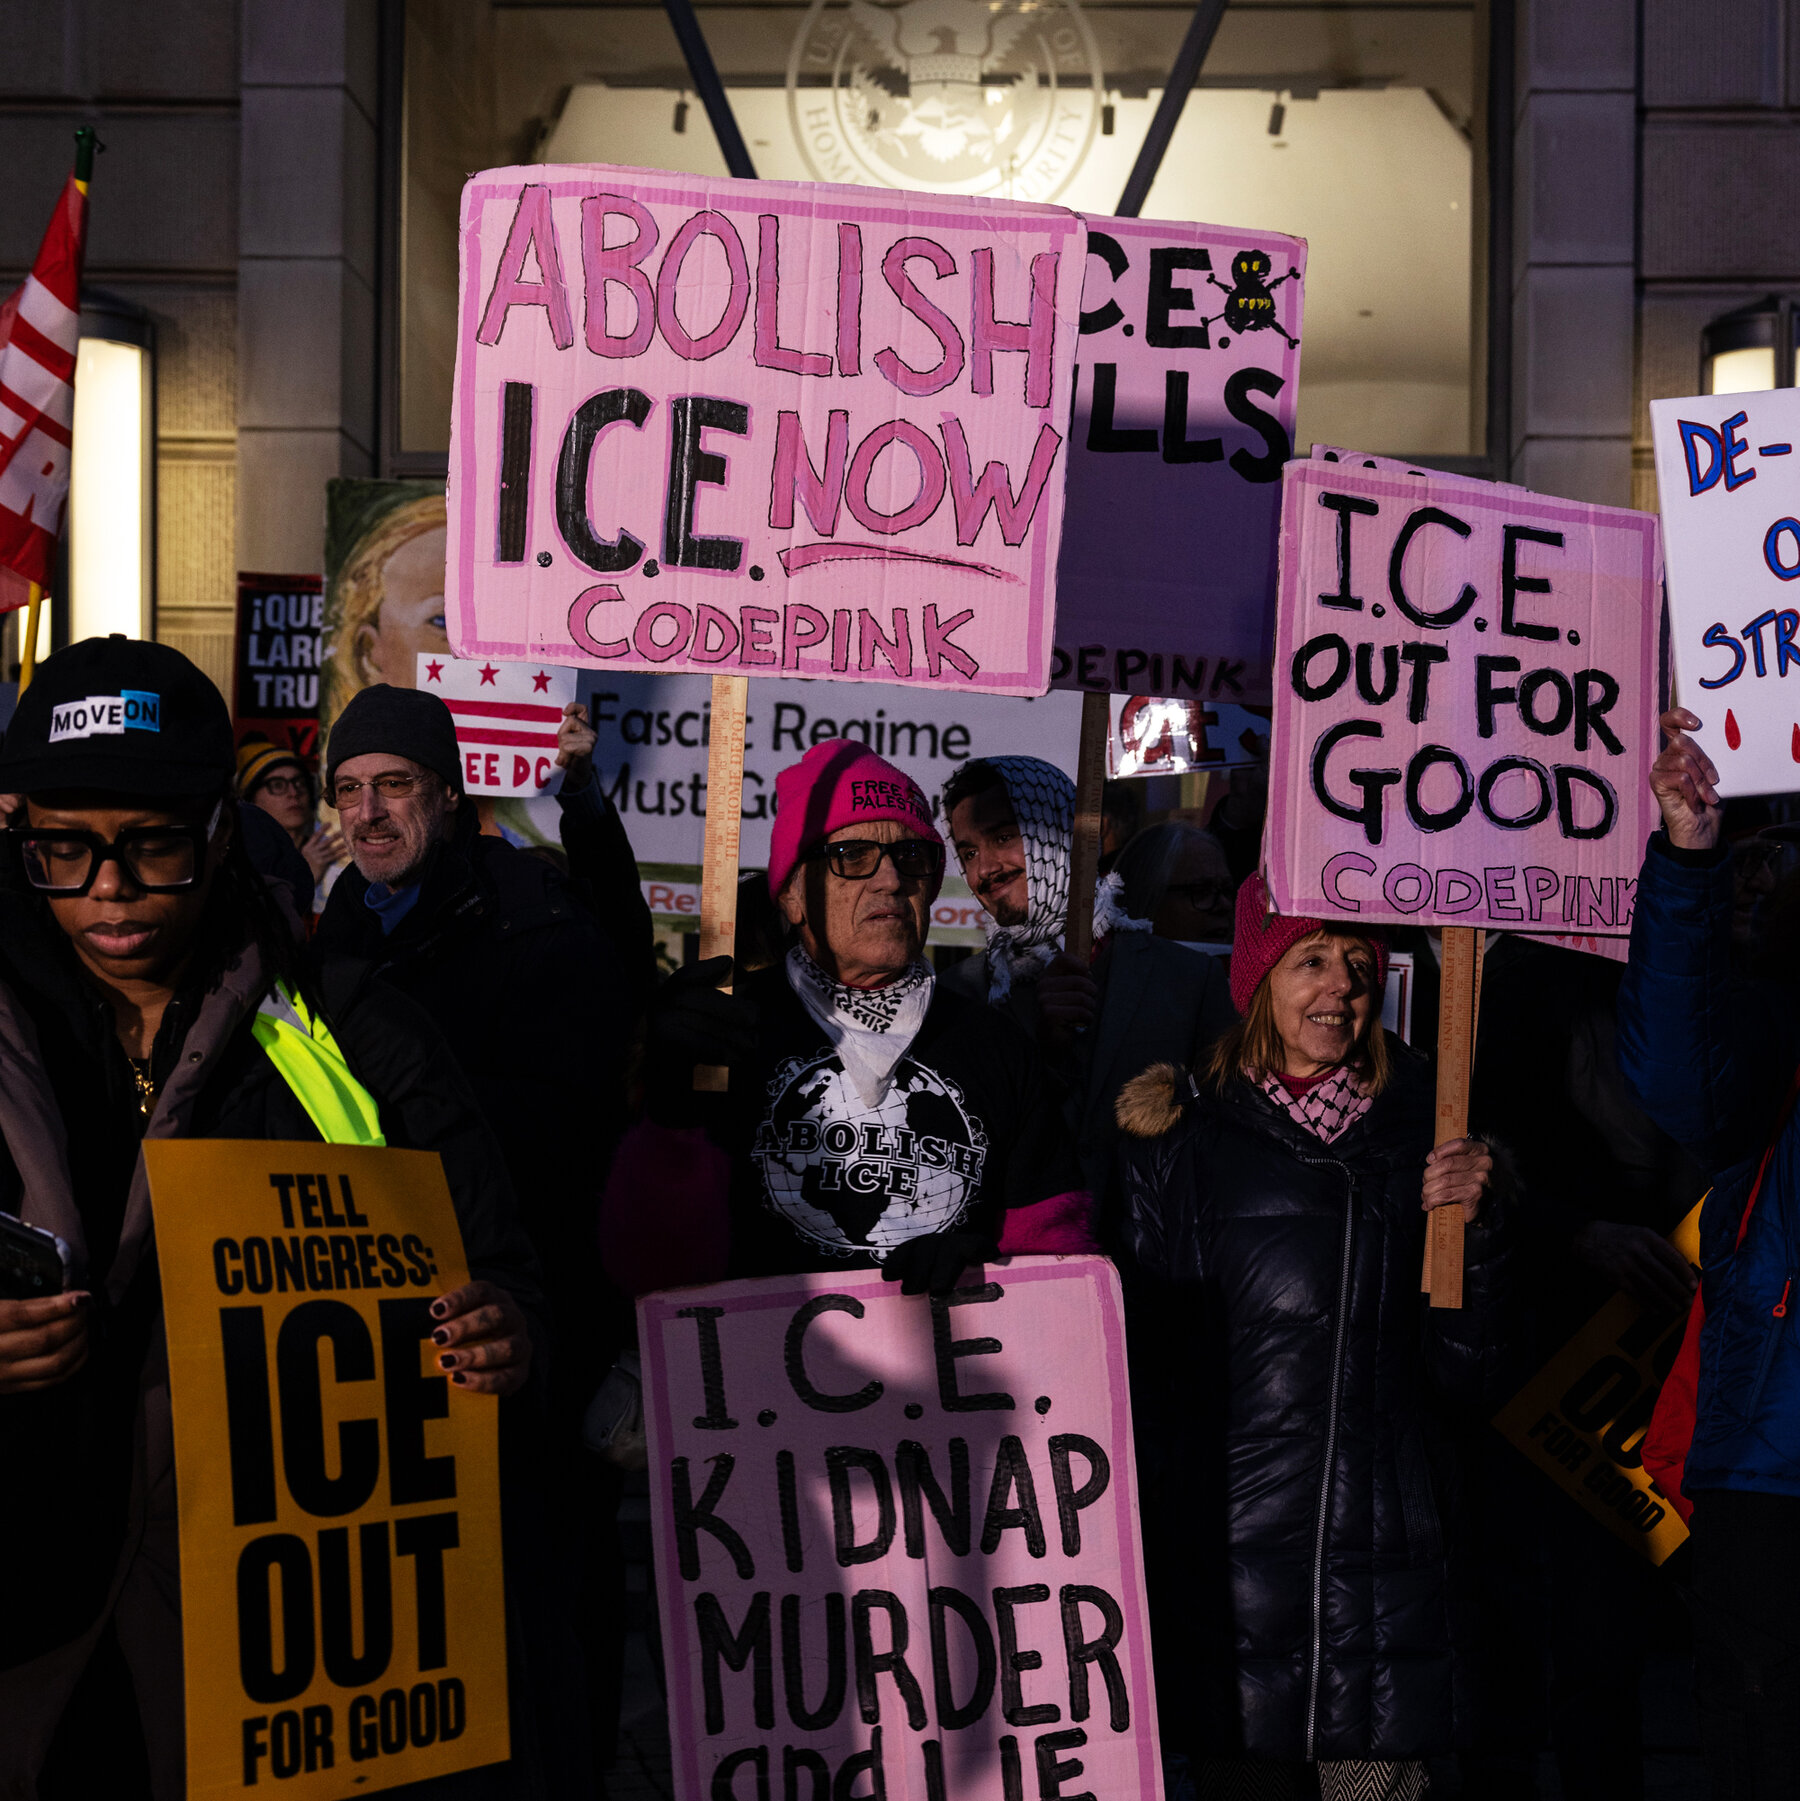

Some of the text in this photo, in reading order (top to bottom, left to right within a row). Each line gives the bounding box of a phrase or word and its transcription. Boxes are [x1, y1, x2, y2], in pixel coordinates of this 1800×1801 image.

[476, 183, 1060, 409] ABOLISH
[493, 380, 1063, 581] I.C.E. NOW
[1676, 410, 1793, 496] DE-
[1317, 490, 1581, 646] I.C.E.
[567, 584, 979, 681] CODEPINK
[1290, 632, 1626, 756] OUT FOR
[513, 754, 552, 789] DC
[725, 708, 745, 861] THE HOME DEPOT
[851, 780, 903, 797] FREE
[1309, 718, 1619, 846] GOOD
[1320, 851, 1639, 927] CODEPINK
[268, 1173, 369, 1230] TELL
[750, 1119, 988, 1187] ABOLISH
[819, 1156, 919, 1201] ICE
[212, 1233, 438, 1296] CONGRESS:
[218, 1296, 458, 1527] ICE
[675, 1282, 1053, 1430] I.C.E.
[671, 1433, 1111, 1582] KIDNAP
[1526, 1411, 1667, 1534] FOR GOOD
[236, 1511, 460, 1704] OUT
[694, 1583, 1131, 1735] MURDER
[242, 1677, 466, 1786] FOR GOOD
